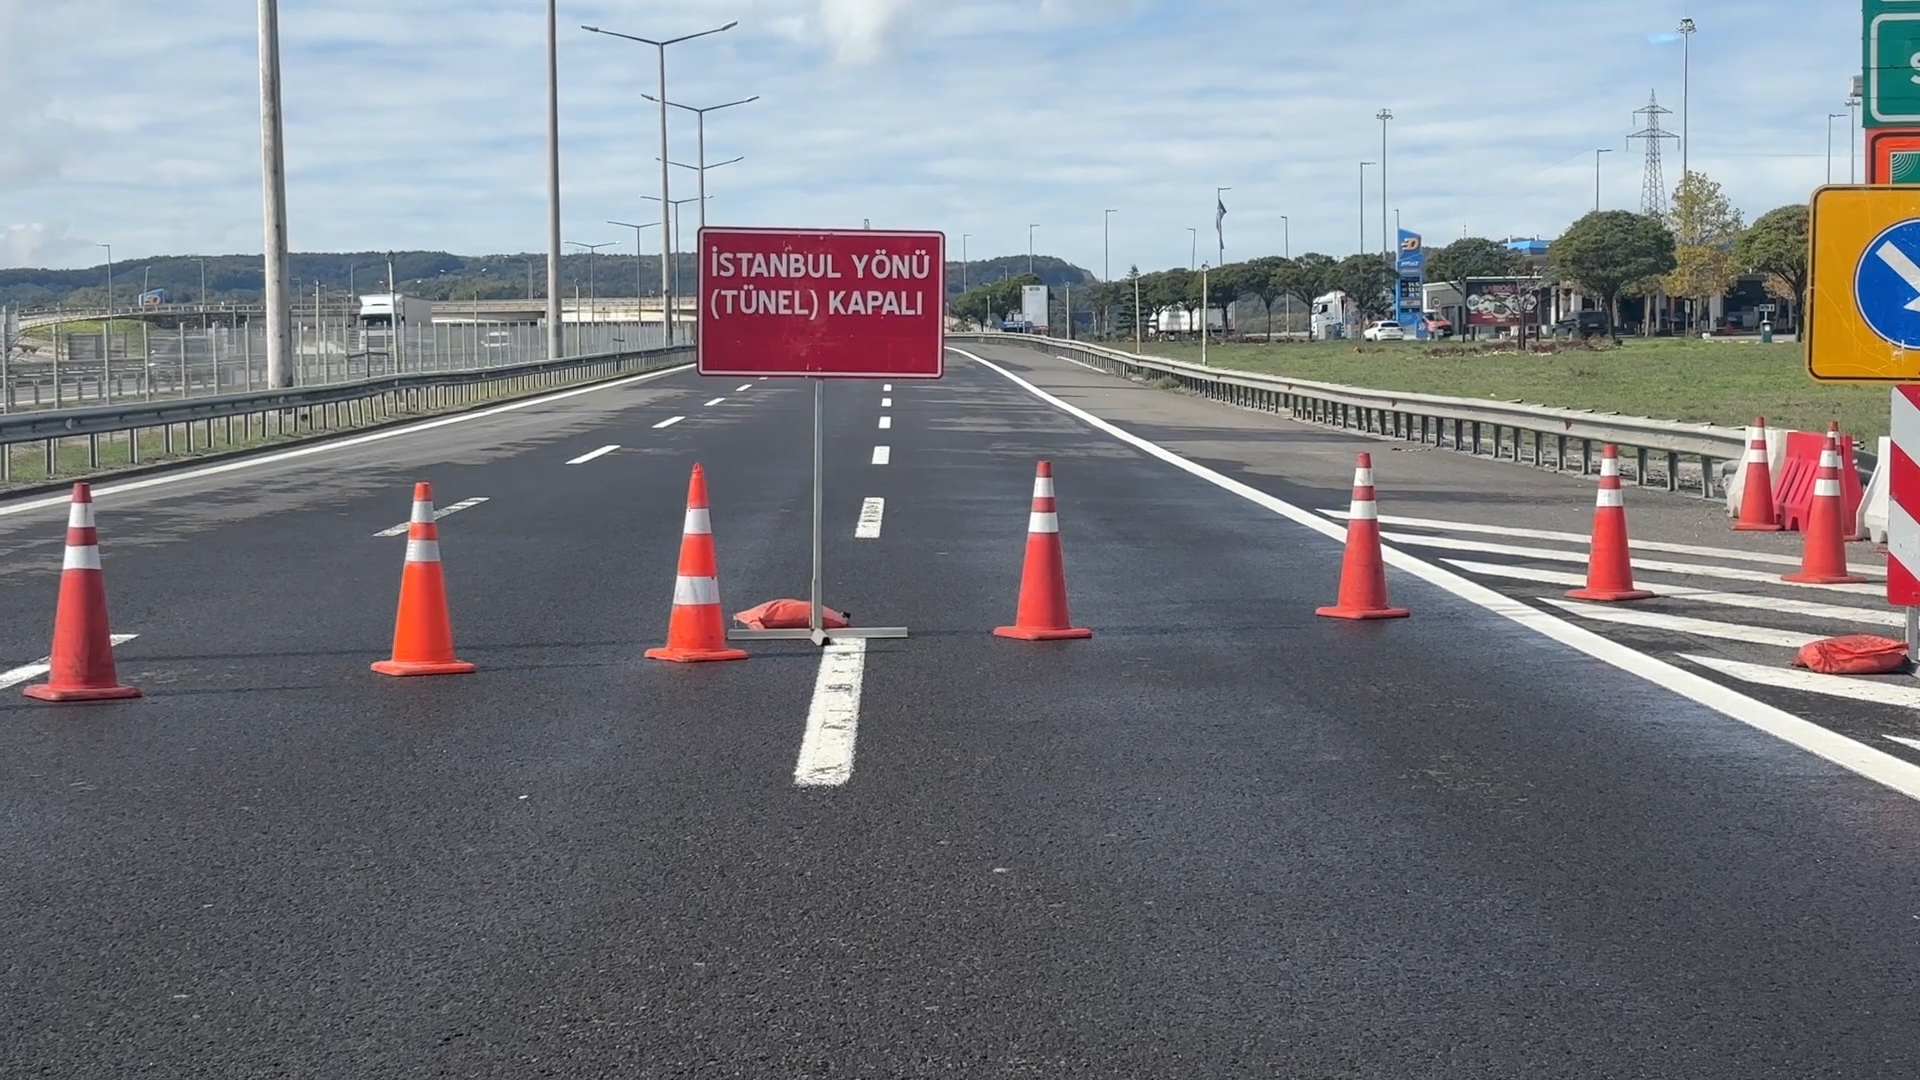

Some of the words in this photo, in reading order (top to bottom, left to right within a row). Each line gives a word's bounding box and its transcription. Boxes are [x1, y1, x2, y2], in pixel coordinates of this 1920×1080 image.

[711, 246, 842, 278] İSTANBUL
[851, 249, 930, 279] YÖNÜ
[711, 285, 819, 320] (TÜNEL)
[829, 291, 923, 315] KAPALI
